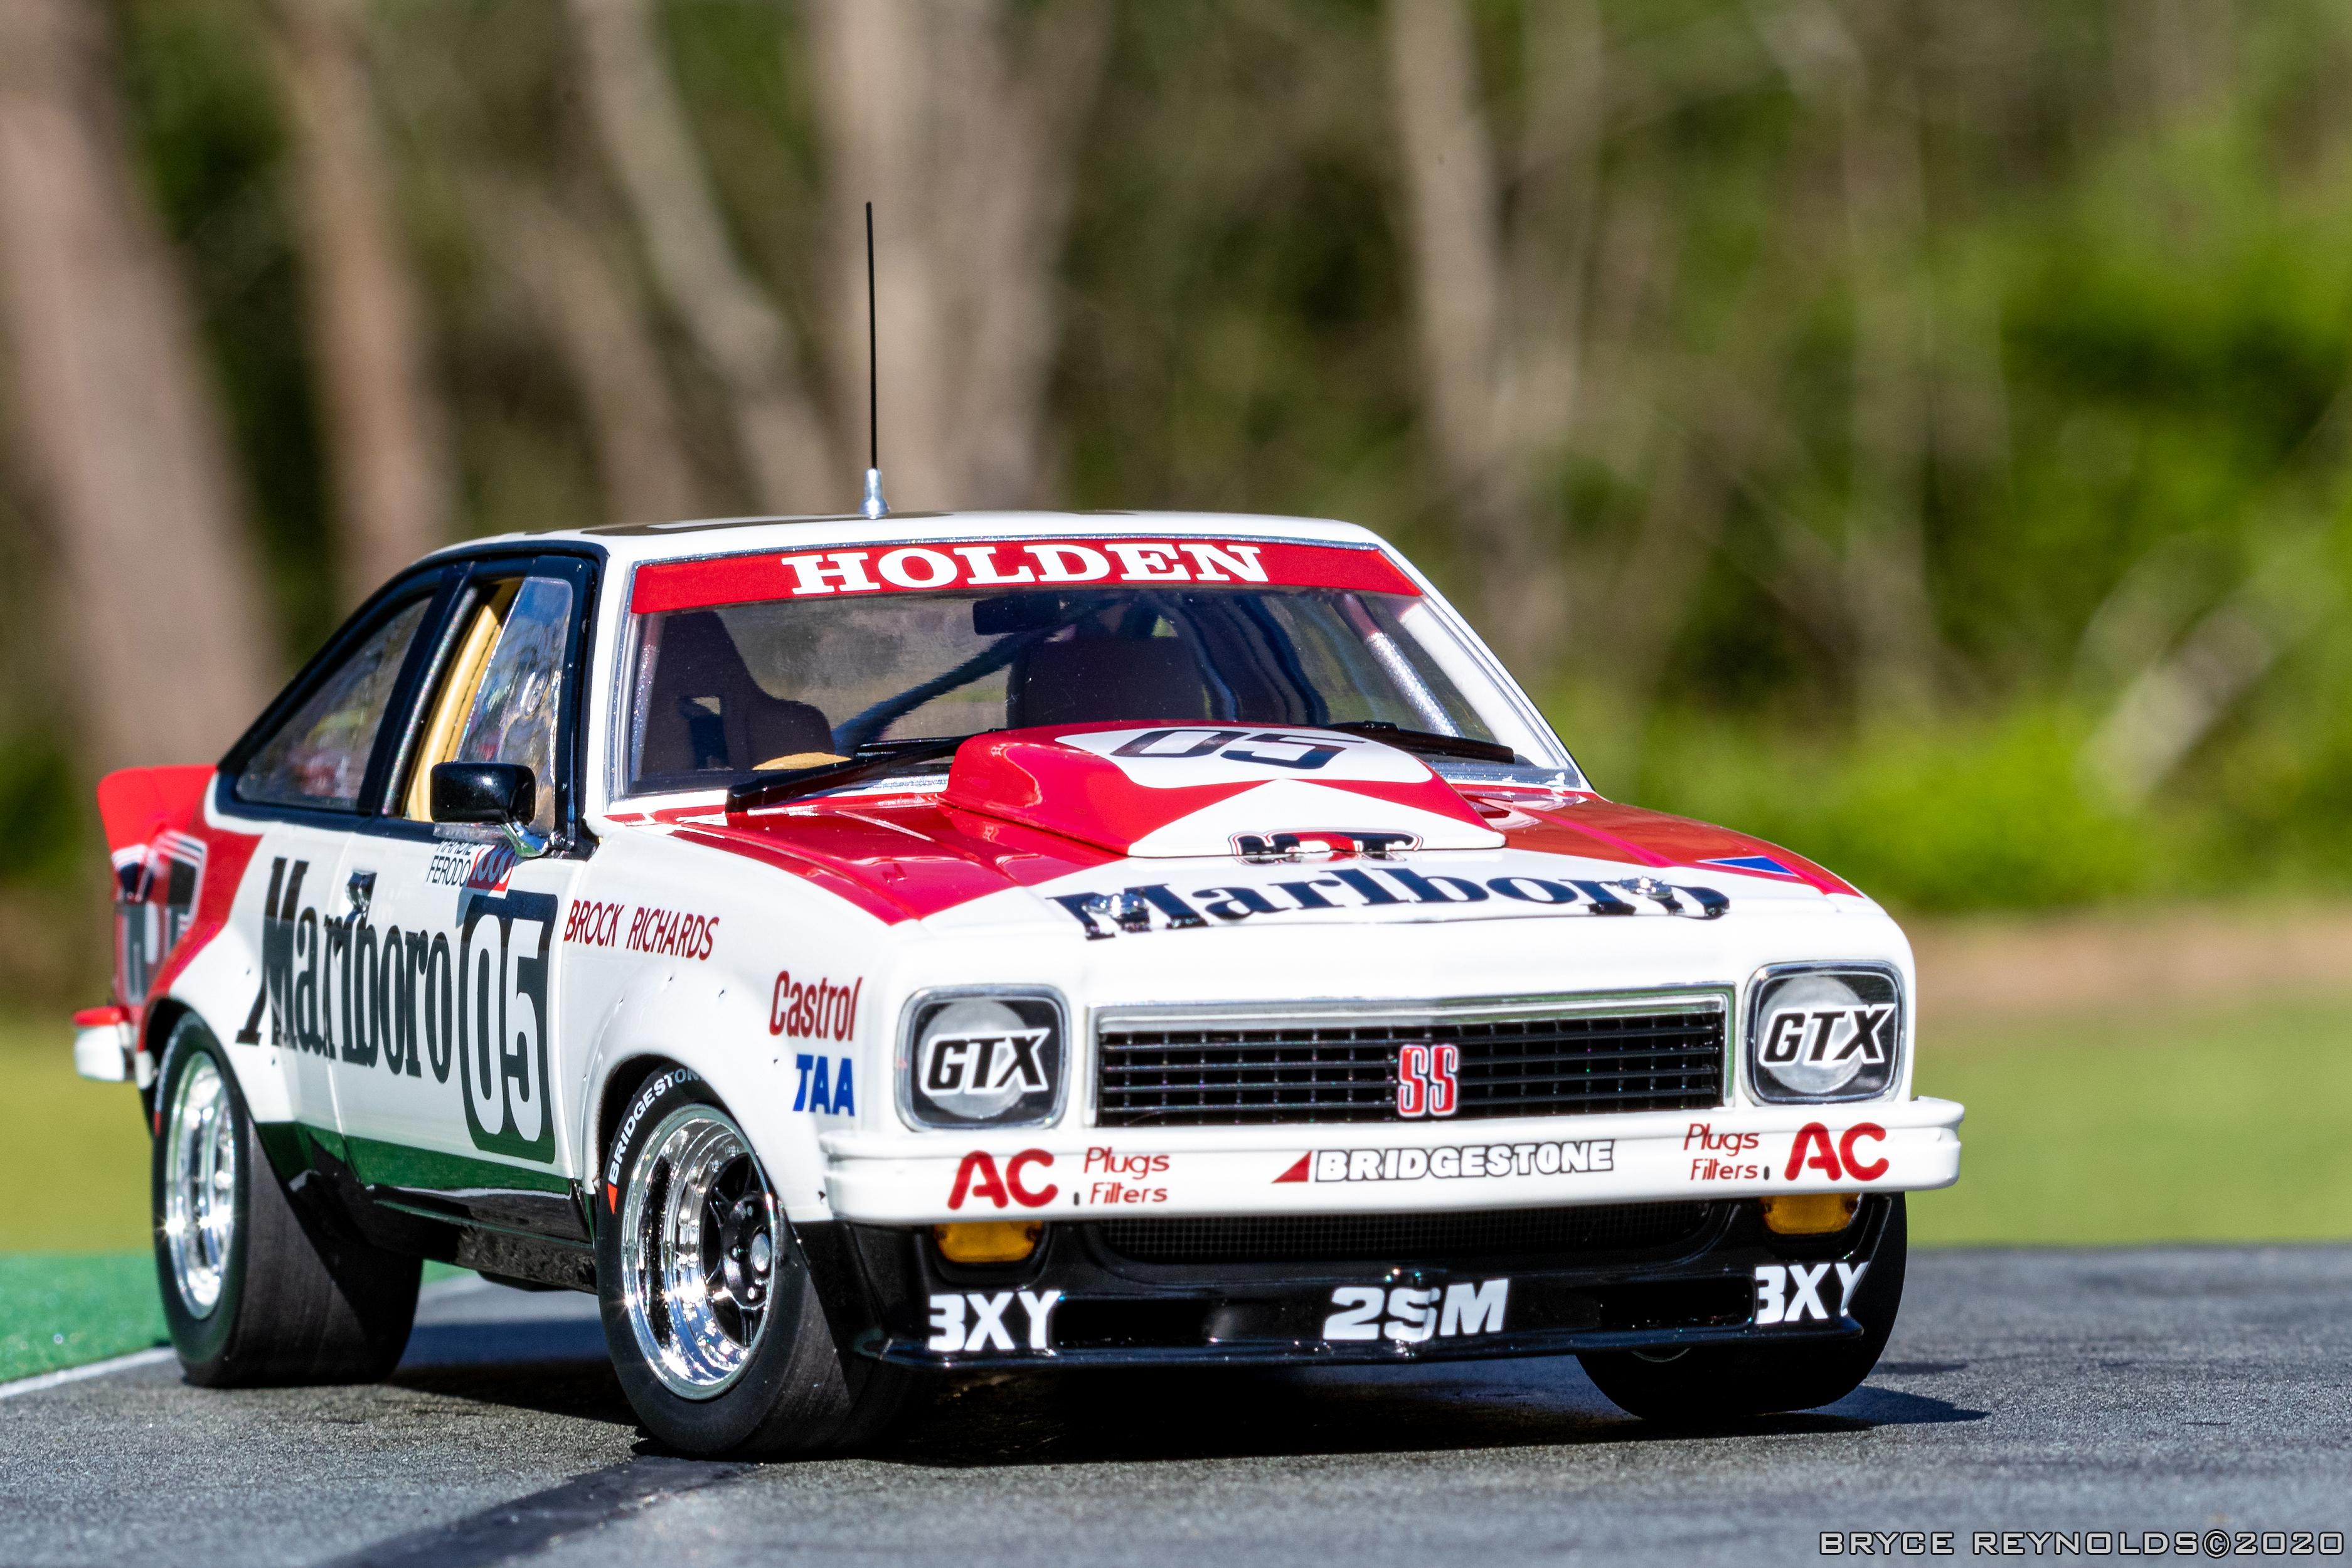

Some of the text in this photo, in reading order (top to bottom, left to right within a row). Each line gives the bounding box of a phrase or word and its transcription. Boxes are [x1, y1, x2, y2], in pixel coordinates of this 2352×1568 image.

[781, 543, 1269, 595] HOLDEN
[1109, 729, 1369, 770] 05
[425, 855, 471, 887] FERODO
[564, 899, 720, 961] BROCK RICHARDS
[1046, 867, 1730, 940] Marlboro
[235, 857, 452, 1084] Marlboro
[466, 914, 545, 1142] 05
[769, 970, 863, 1042] Castrol
[1759, 1003, 1895, 1067] GTX
[792, 1054, 856, 1116] TAA
[920, 1028, 1050, 1096] GTX
[1398, 1044, 1459, 1117] SS
[608, 1068, 700, 1185] BRIDGESTON
[1684, 1123, 1760, 1157] Plugs
[1784, 1121, 1890, 1182] AC
[947, 1148, 1058, 1210] AC
[1084, 1147, 1171, 1180] Plugs
[1314, 1139, 1616, 1183] BRIDGESTONE
[1690, 1158, 1759, 1181] Filters
[1090, 1182, 1168, 1205] Filters
[928, 1290, 1062, 1353] 3XY
[1322, 1278, 1509, 1343] 2SM
[1755, 1261, 1870, 1325] 3XY
